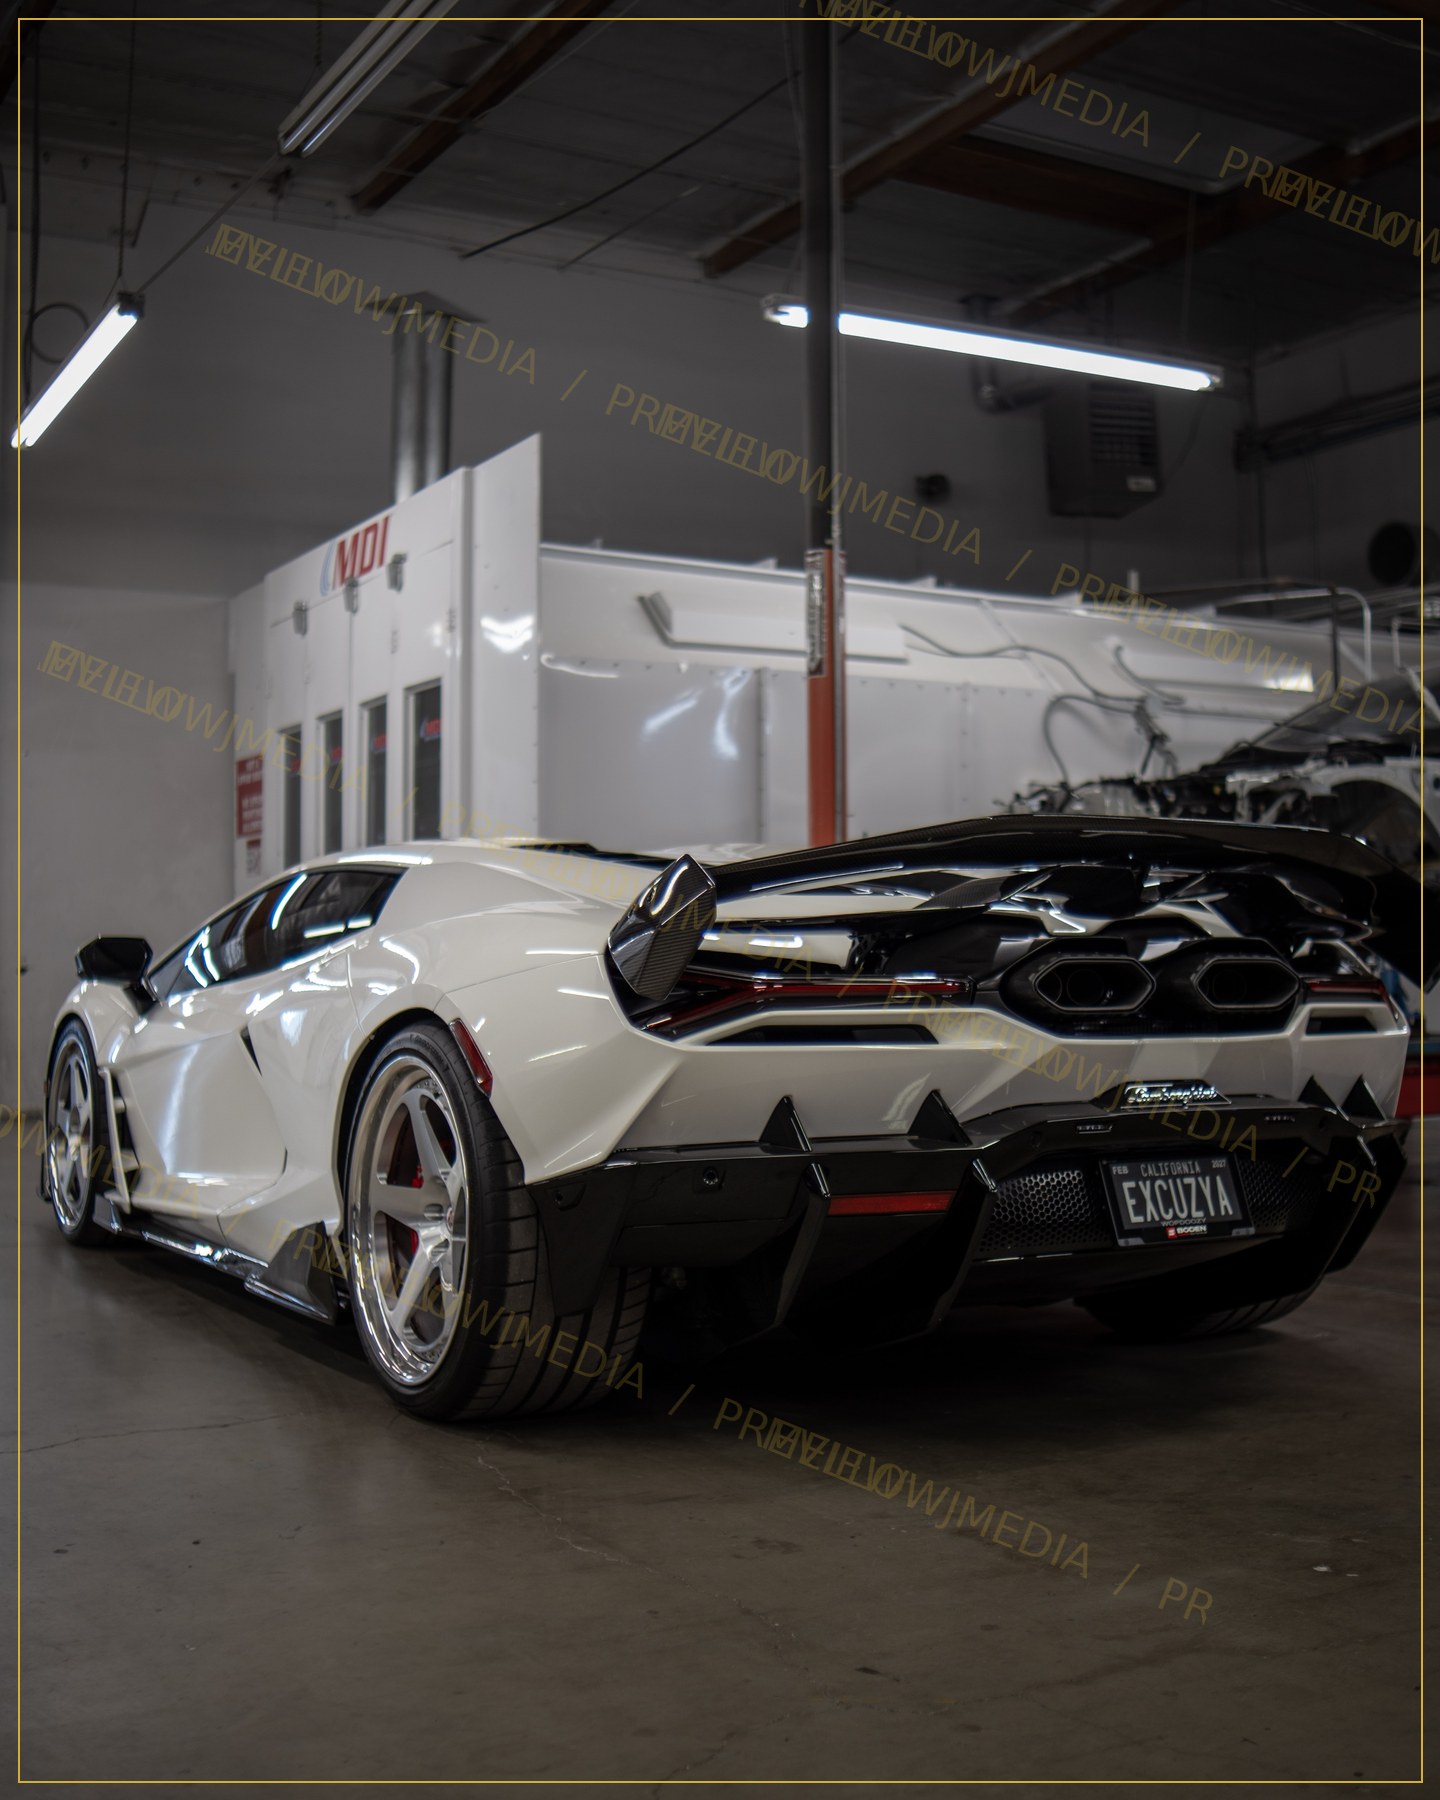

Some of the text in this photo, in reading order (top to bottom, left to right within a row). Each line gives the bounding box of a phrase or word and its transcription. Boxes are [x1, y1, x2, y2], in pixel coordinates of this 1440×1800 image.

[332, 515, 389, 591] MDI
[1112, 1165, 1129, 1176] FEB
[1140, 1160, 1202, 1178] CALIFORNIA
[1122, 1174, 1234, 1224] EXCUZYA
